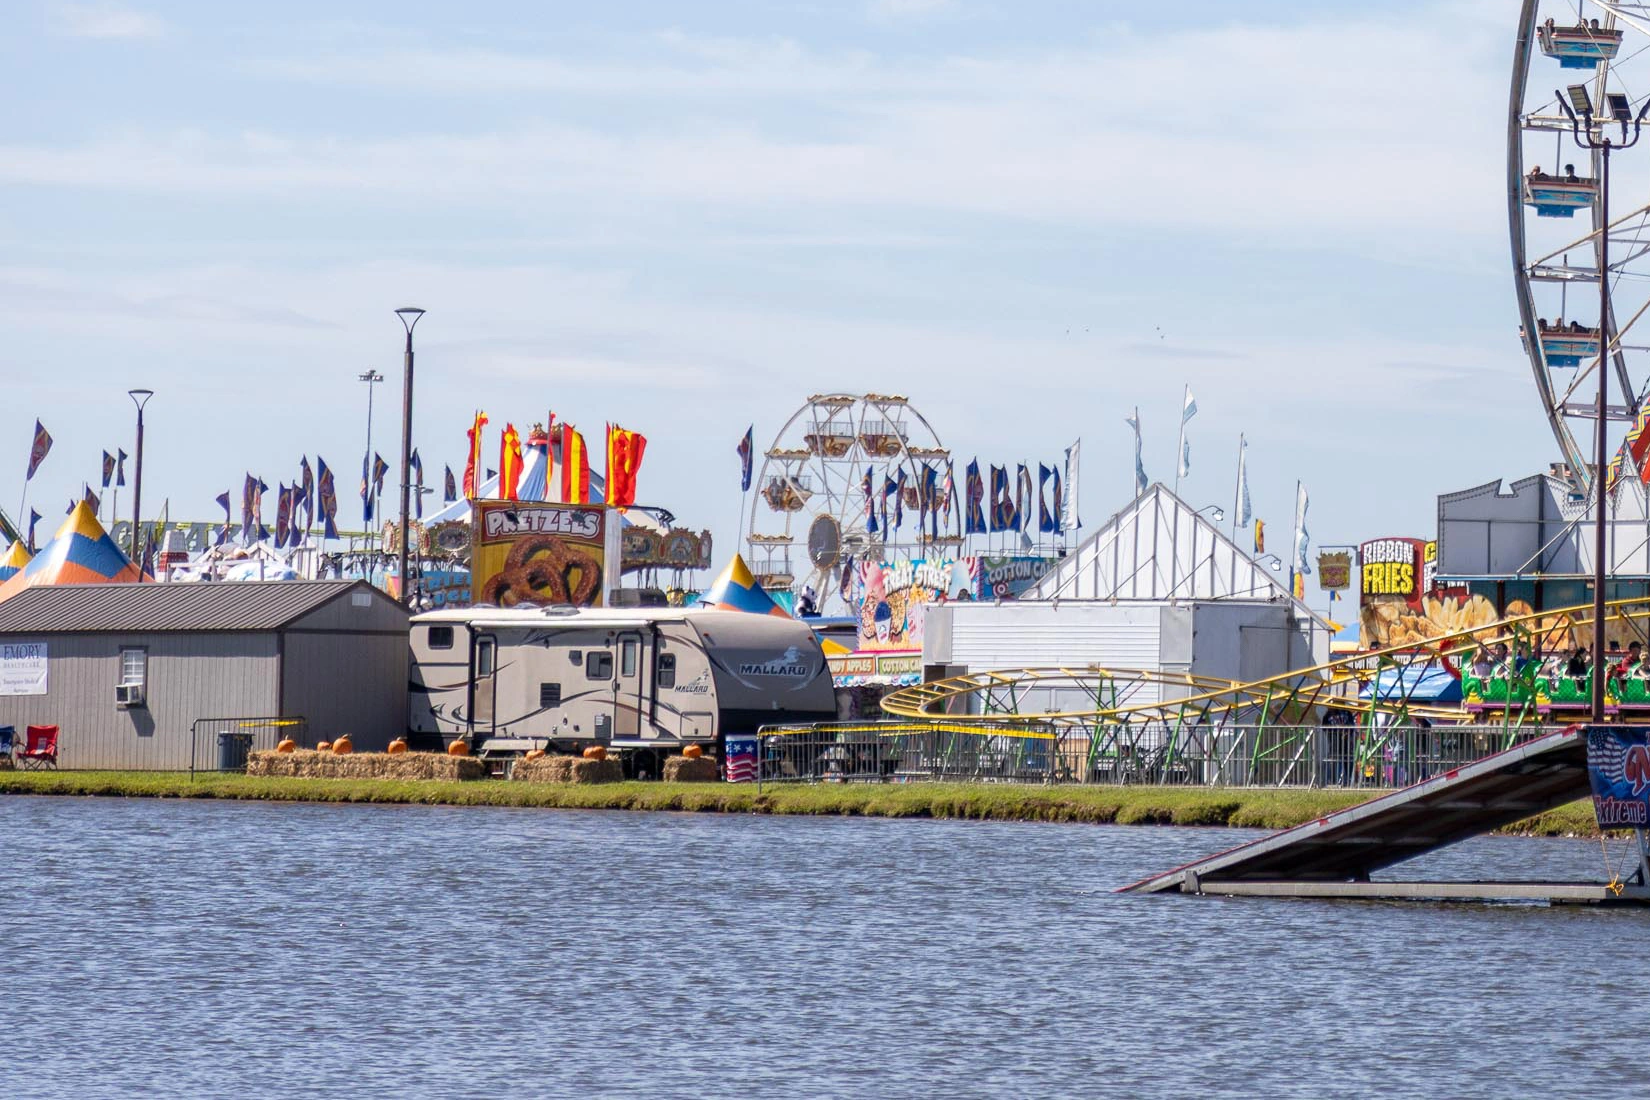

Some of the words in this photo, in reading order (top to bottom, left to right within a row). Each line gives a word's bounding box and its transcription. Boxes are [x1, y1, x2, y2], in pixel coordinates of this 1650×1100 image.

[486, 506, 599, 538] PRETZELS
[1363, 540, 1414, 565] RIBBON
[882, 563, 914, 595] TREAT
[914, 562, 952, 596] STREET
[988, 561, 1032, 583] COTTON
[1363, 563, 1414, 594] FRIES
[3, 644, 42, 660] EMORY
[739, 663, 808, 677] MALLARD
[674, 684, 709, 693] MALLARD
